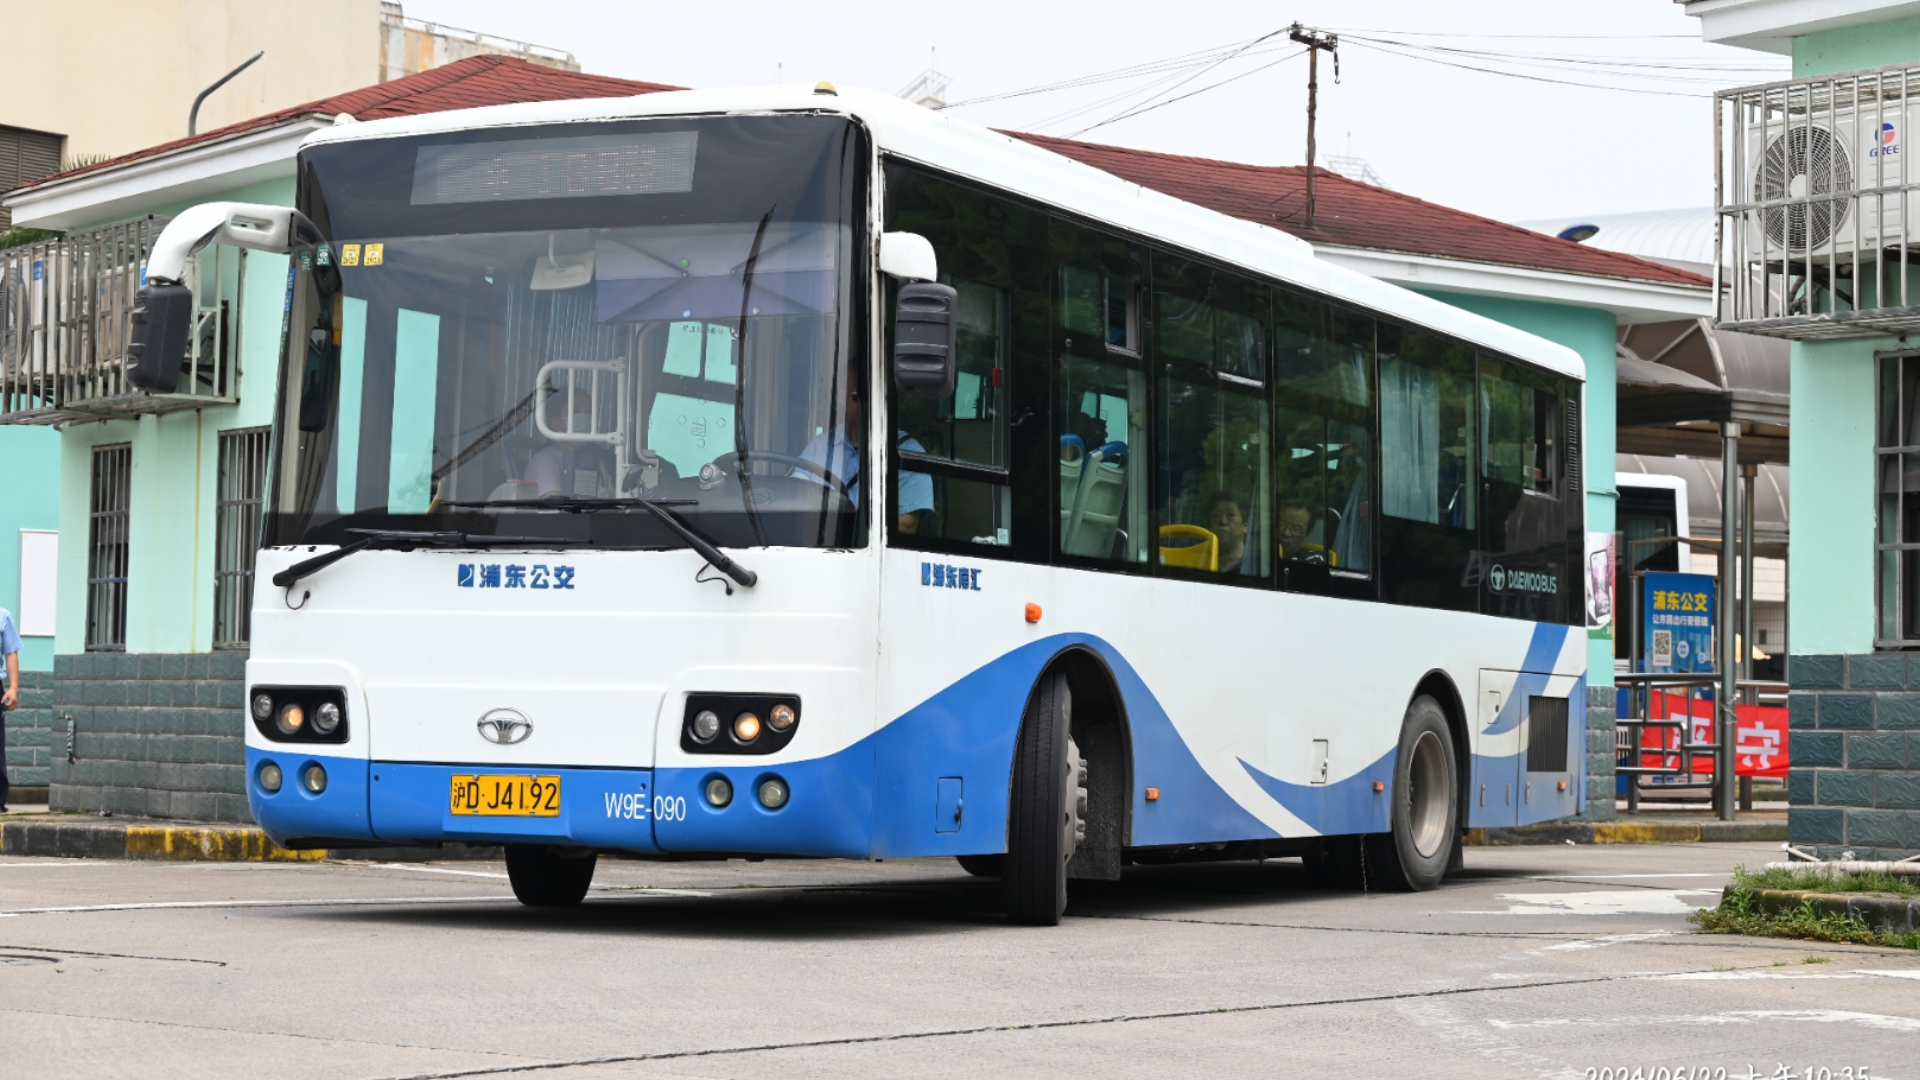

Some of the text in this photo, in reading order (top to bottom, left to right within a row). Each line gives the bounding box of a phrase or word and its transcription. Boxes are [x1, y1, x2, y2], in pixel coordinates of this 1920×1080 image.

[1869, 145, 1900, 157] GREE
[479, 563, 575, 589] 浦东公交
[932, 563, 982, 591] 浦东南汇
[1653, 591, 1708, 612] 浦东公交
[604, 792, 687, 822] W9E-090
